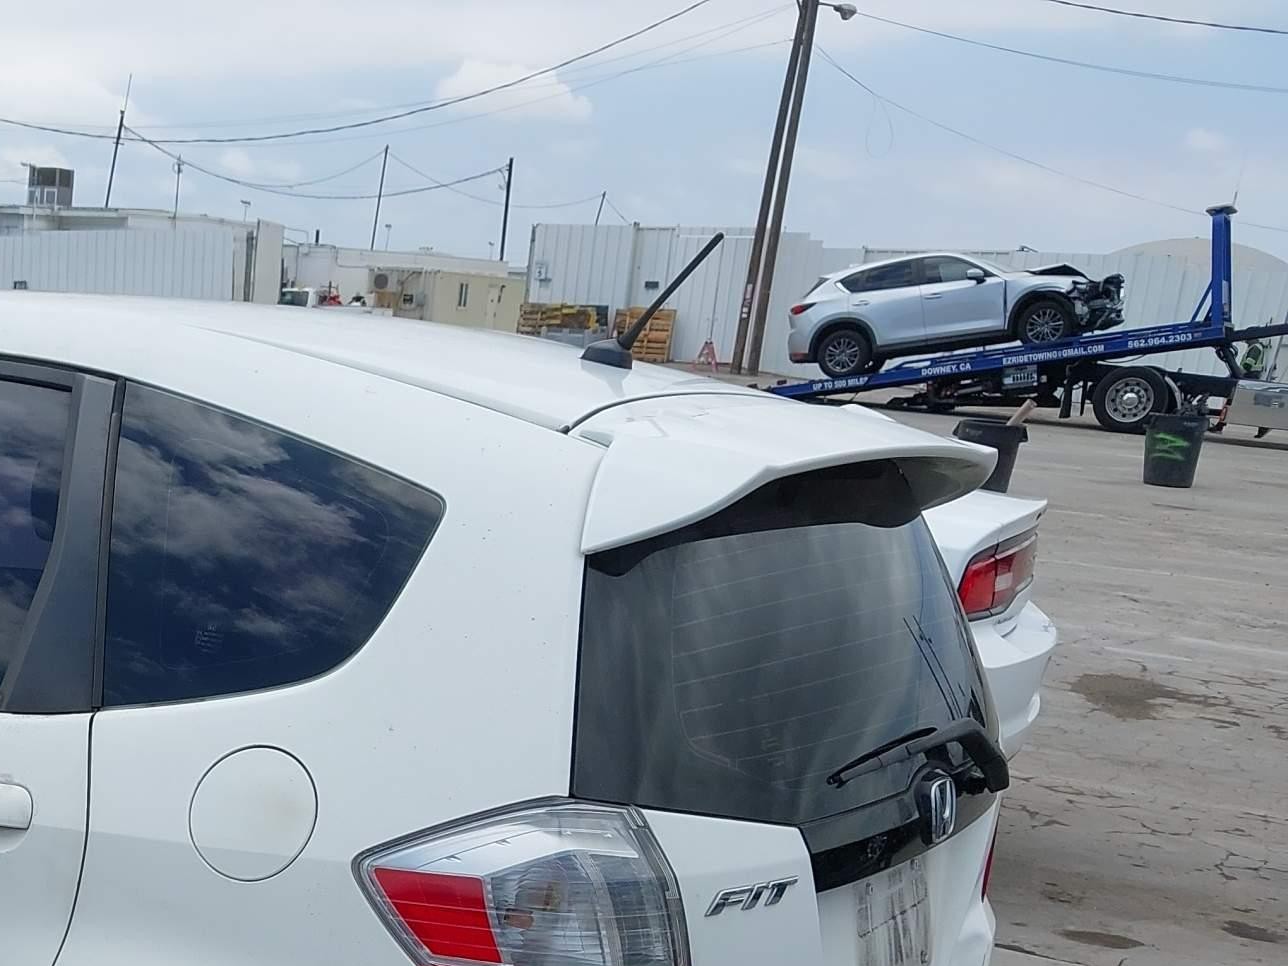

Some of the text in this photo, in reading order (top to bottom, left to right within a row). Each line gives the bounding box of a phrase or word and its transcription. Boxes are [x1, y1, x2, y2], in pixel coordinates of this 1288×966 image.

[1127, 333, 1192, 349] 562.964.2303
[960, 362, 971, 371] CA
[813, 383, 822, 391] UP
[824, 381, 832, 390] TO
[704, 875, 799, 917] FIT
